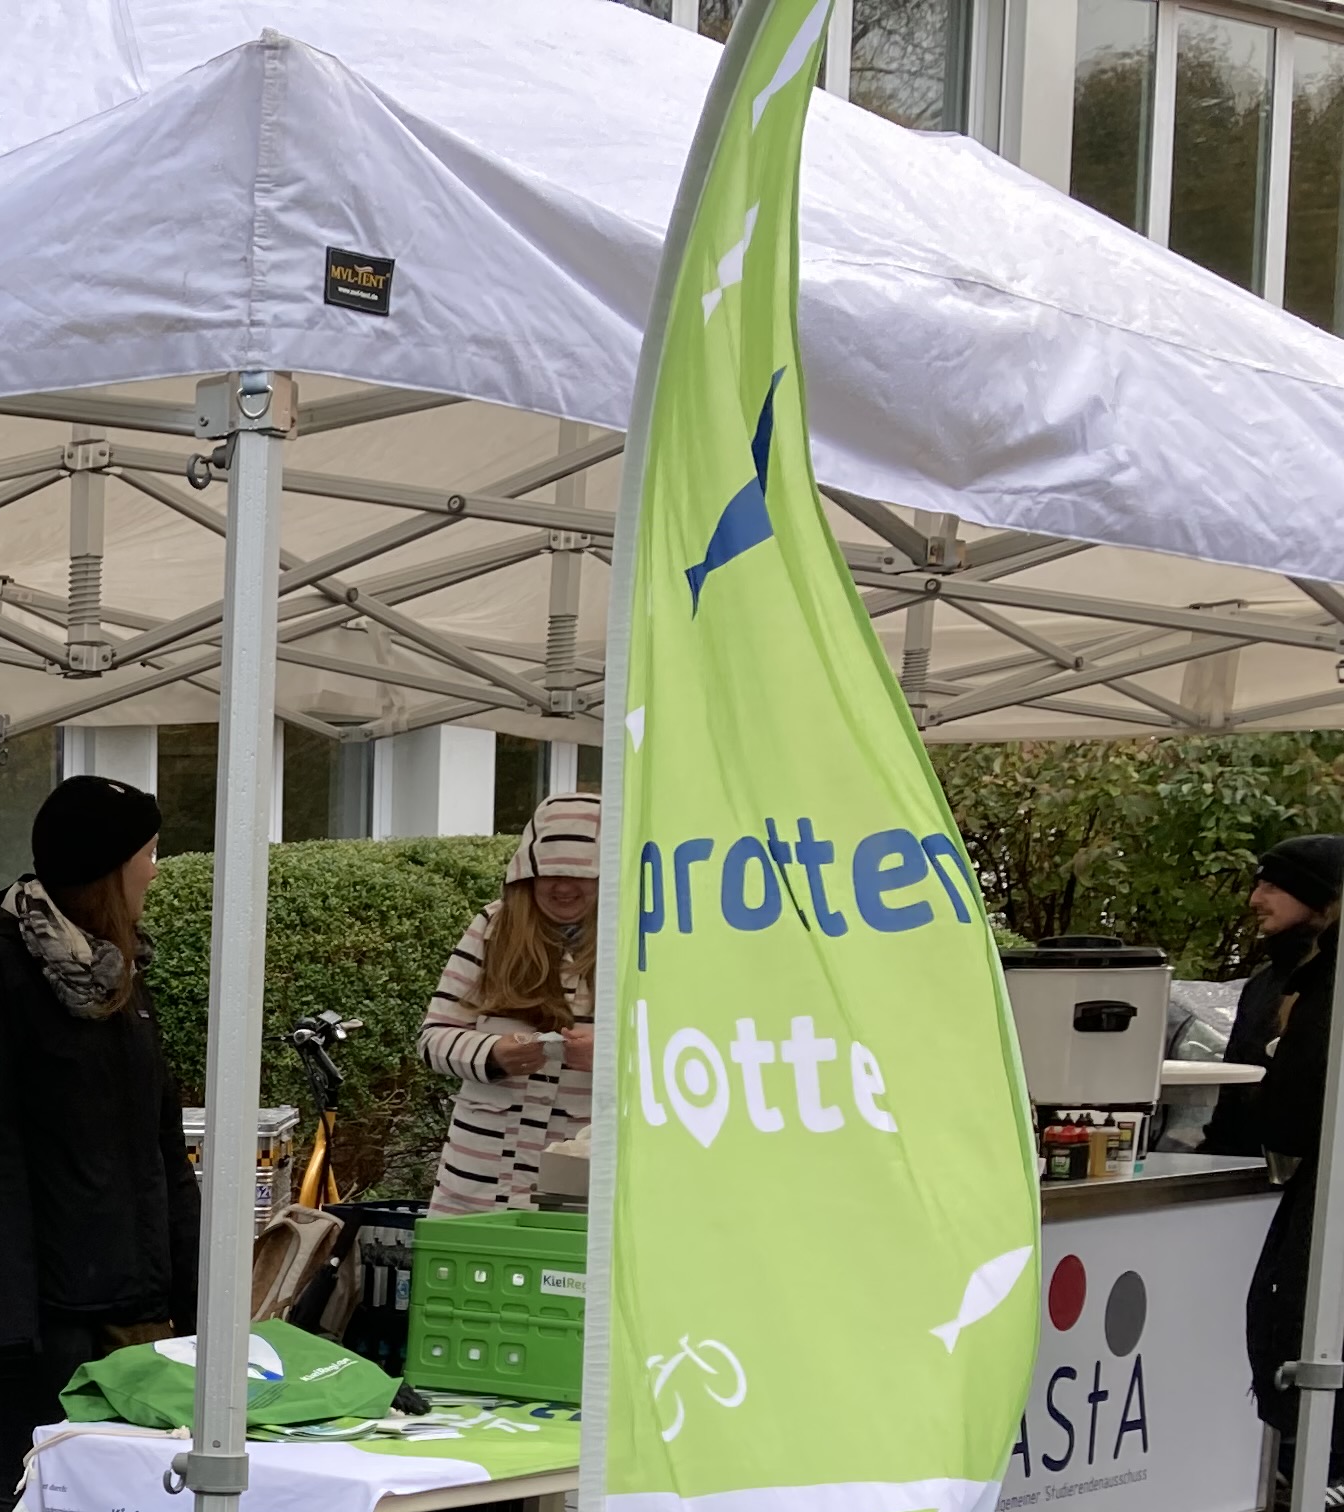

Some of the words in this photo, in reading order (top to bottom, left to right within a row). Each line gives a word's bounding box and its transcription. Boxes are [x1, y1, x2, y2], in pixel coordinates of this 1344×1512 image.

[331, 265, 385, 289] MVL-TENT
[638, 817, 973, 972] protten
[628, 1000, 898, 1148] lotte
[543, 1275, 587, 1294] KielReg
[1045, 1468, 1148, 1502] Studierendenausschuss
